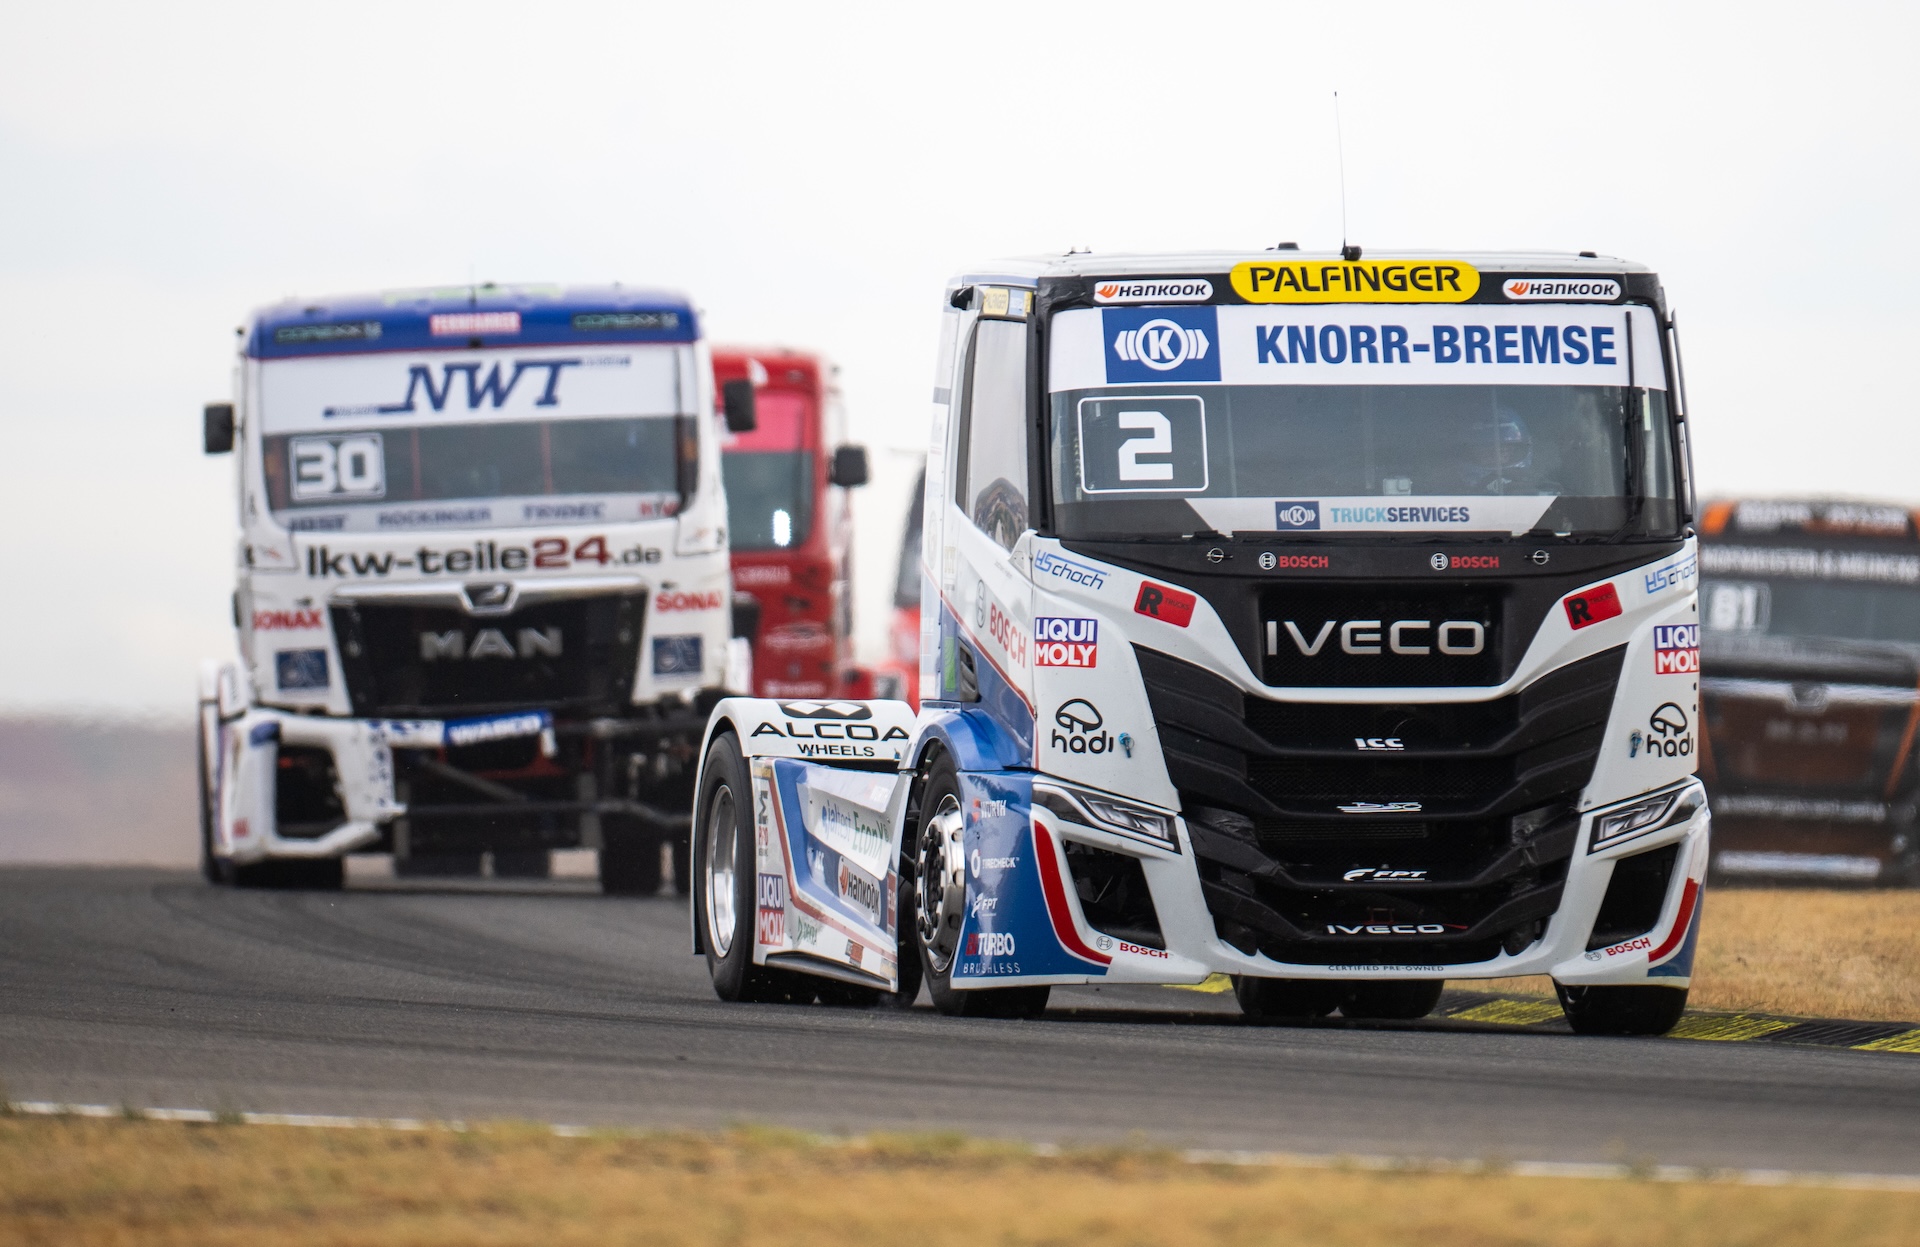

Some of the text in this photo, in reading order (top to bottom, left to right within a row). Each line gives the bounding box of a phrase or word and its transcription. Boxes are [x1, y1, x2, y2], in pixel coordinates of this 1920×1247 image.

[1249, 265, 1462, 293] PALFINGER
[1256, 324, 1617, 365] KNORR-BREMSE
[404, 358, 580, 411] NWT
[1117, 411, 1174, 481] 2
[296, 440, 380, 492] 30
[1330, 506, 1470, 524] TRUCKSERVICES
[307, 535, 662, 578] lkw-teile24.de
[1279, 555, 1329, 568] BOSCH
[1450, 555, 1500, 568] BOSCH
[1138, 586, 1163, 616] R
[1568, 598, 1592, 625] R
[990, 604, 1027, 669] BOSCH
[1036, 618, 1096, 643] LIQUI
[1267, 620, 1485, 656] IVECO
[1657, 625, 1698, 648] LIQU
[420, 627, 563, 660] MAN
[1035, 643, 1096, 666] MOLY
[751, 720, 909, 742] ALCOA
[1052, 728, 1113, 754] hadi
[797, 743, 875, 757] WHEELS
[1646, 734, 1694, 757] hadi
[759, 876, 784, 909] LIQUI
[982, 898, 998, 910] FPT
[760, 911, 784, 944] MOLY
[1327, 924, 1445, 934] IVECO
[1120, 943, 1169, 959] BOSCH
[1605, 937, 1651, 956] BOSCH
[963, 961, 1021, 975] BRUSHLESS
